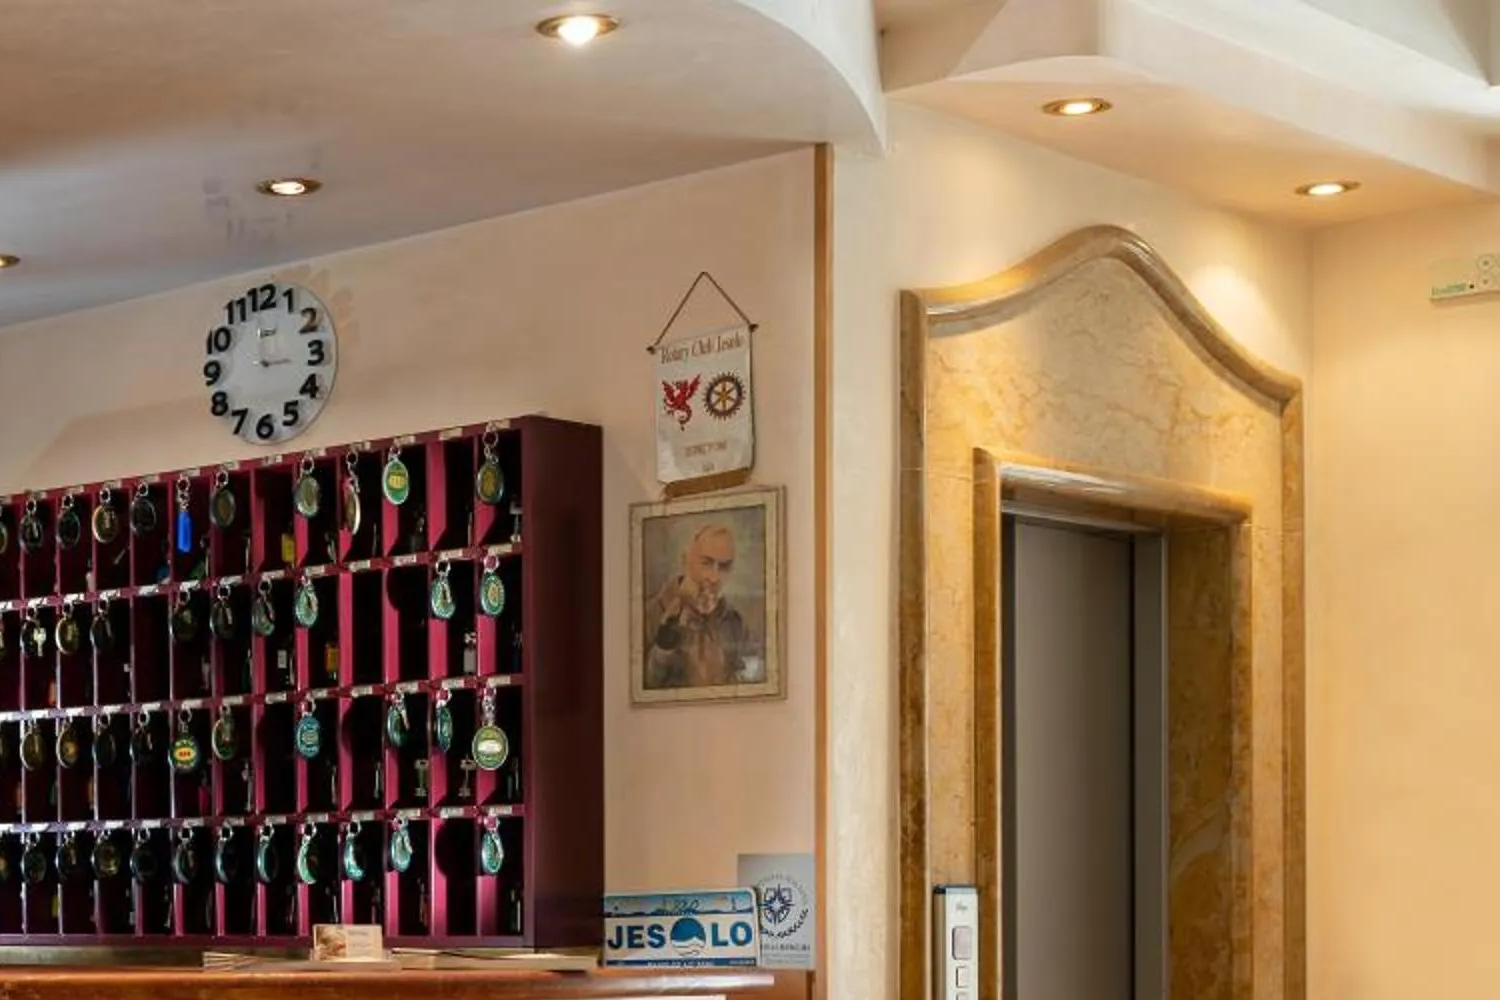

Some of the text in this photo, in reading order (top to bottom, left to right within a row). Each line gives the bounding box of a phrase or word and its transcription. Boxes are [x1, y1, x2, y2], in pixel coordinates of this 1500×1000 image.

[247, 283, 277, 312] 12
[282, 288, 294, 314] 1
[225, 298, 247, 325] 11
[299, 308, 318, 334] 2
[206, 326, 231, 355] 10
[307, 339, 325, 366] 3
[203, 360, 221, 386] 9
[299, 373, 319, 398] 4
[211, 391, 228, 416] 8
[282, 400, 299, 426] 5
[232, 408, 248, 434] 7
[256, 414, 274, 439] 6
